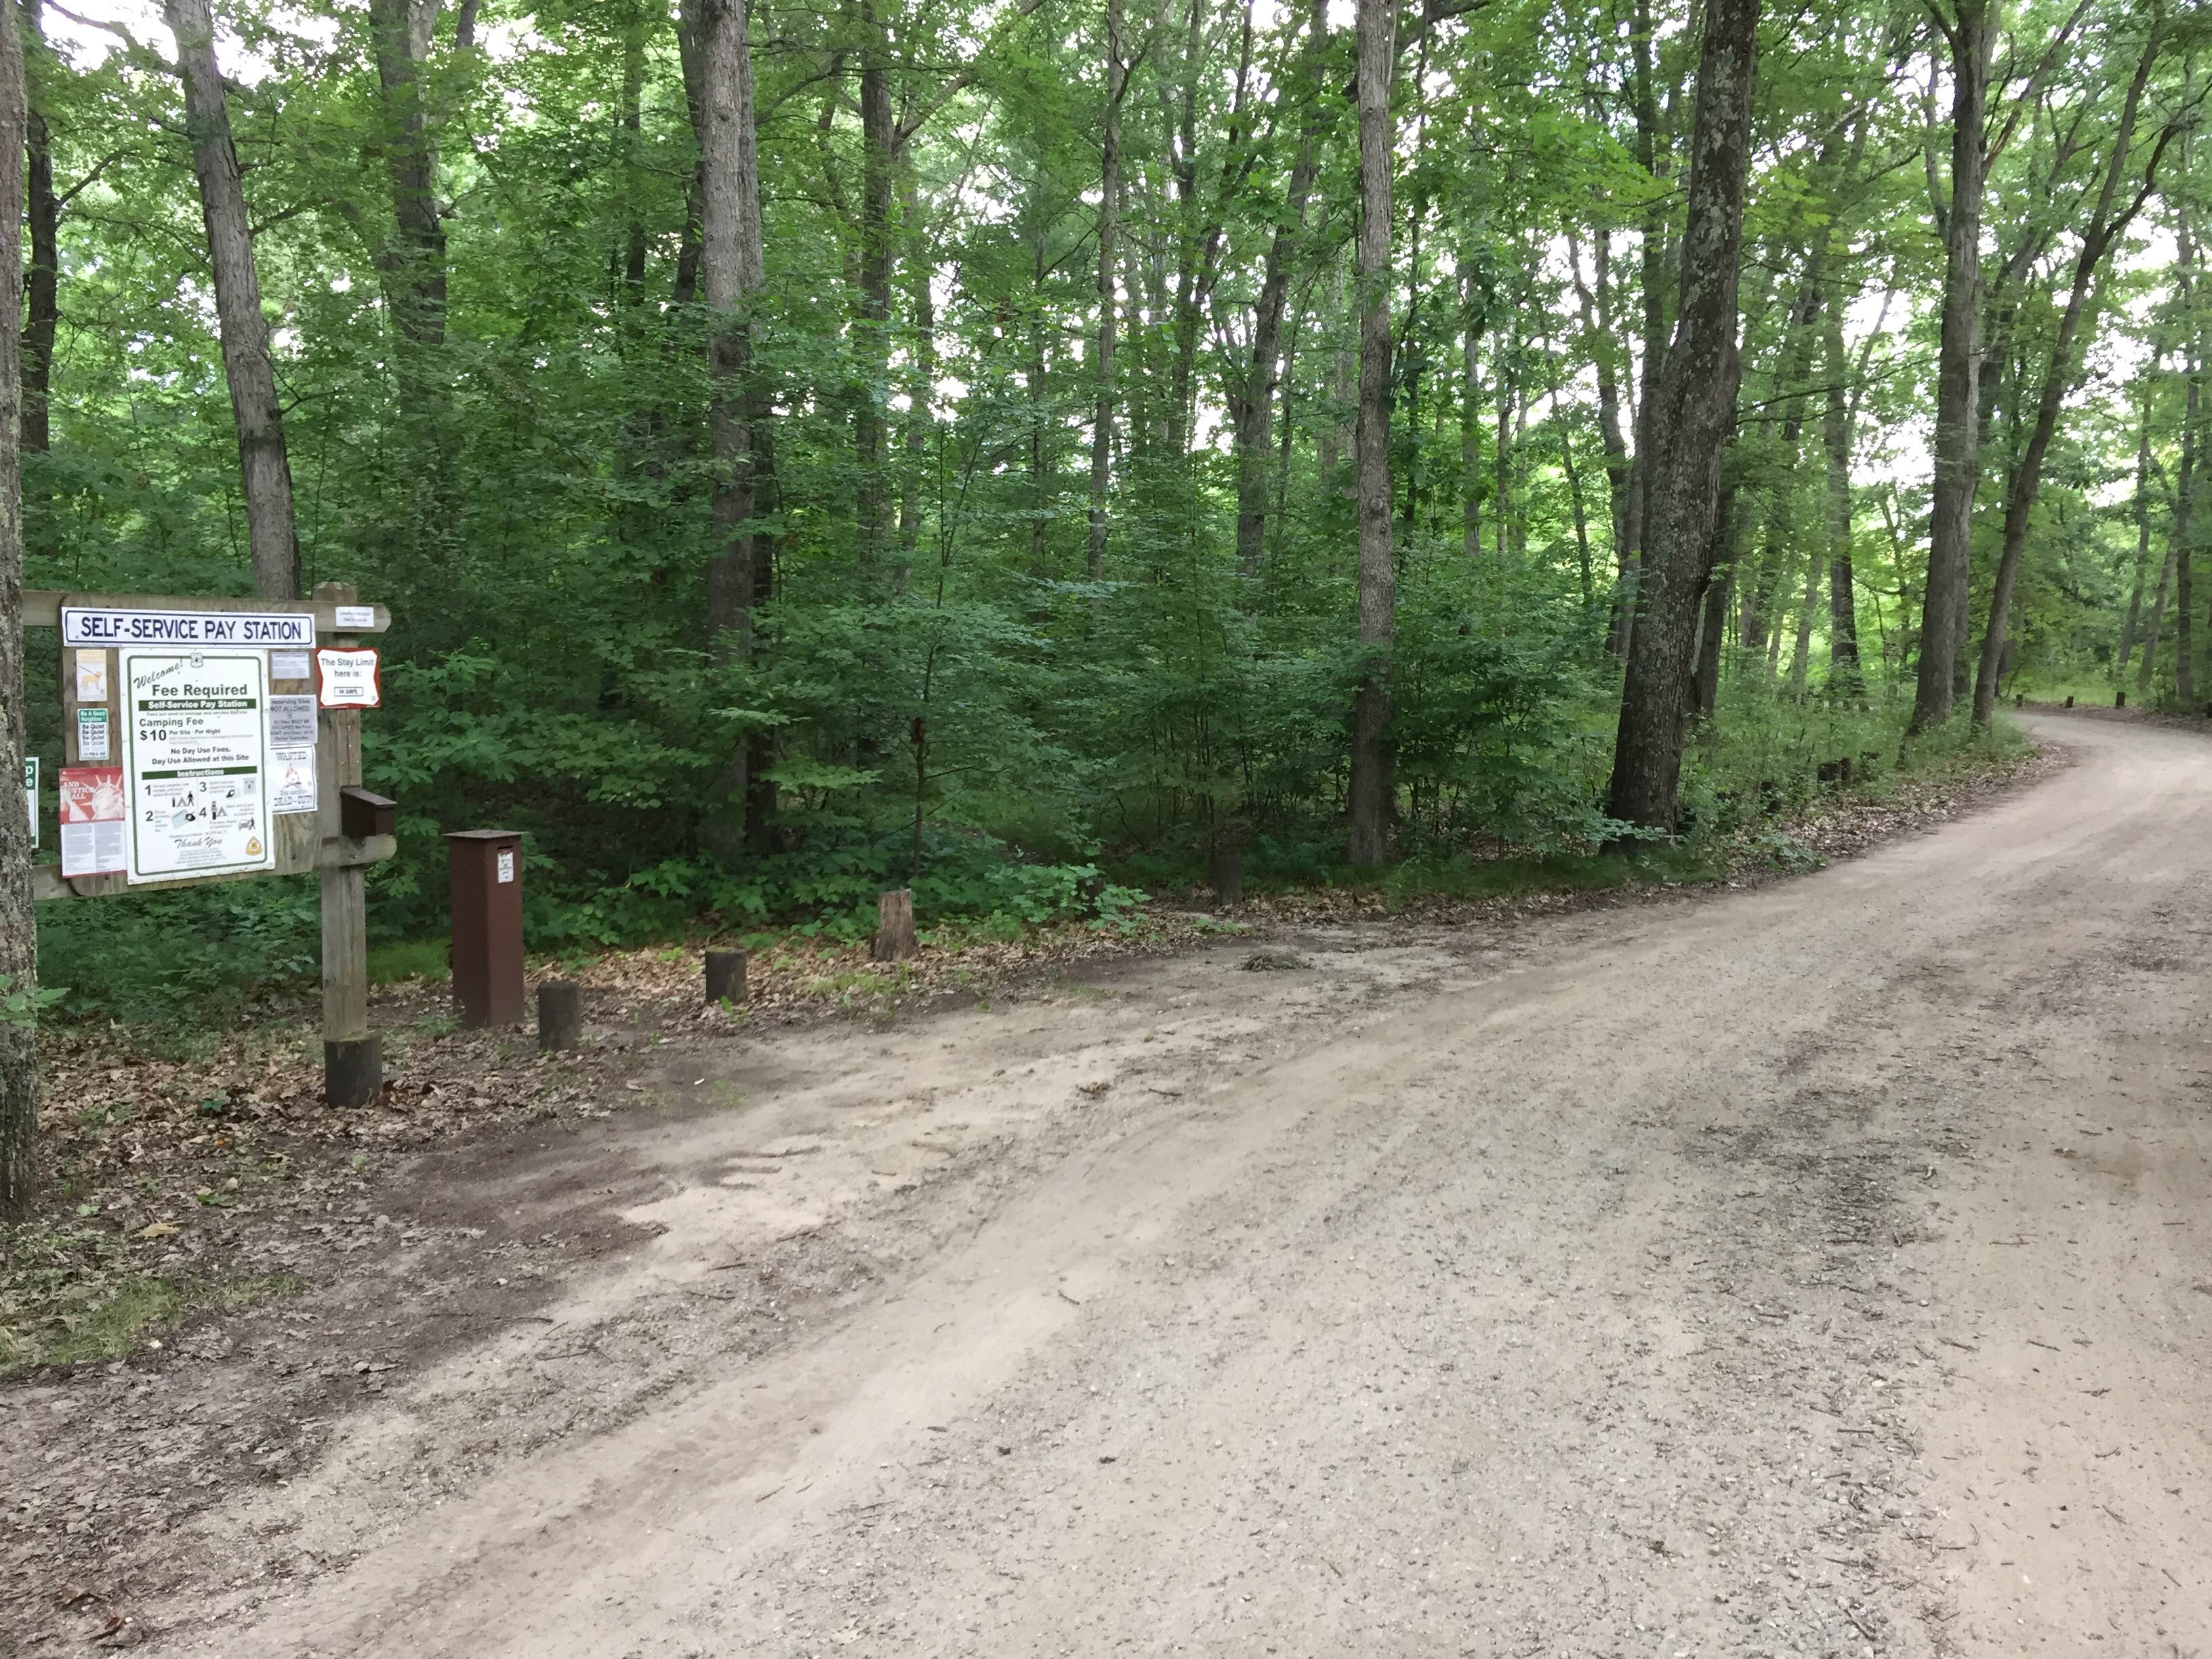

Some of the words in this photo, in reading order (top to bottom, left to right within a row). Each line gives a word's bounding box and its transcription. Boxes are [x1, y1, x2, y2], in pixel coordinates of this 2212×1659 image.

[81, 617, 199, 638] SELF-SERVICE
[205, 620, 236, 639] PAY
[243, 621, 301, 640] STATION
[321, 658, 335, 666] The
[337, 658, 353, 668] Stay
[134, 658, 183, 689] Welcome!
[152, 685, 178, 696] Fee
[184, 684, 247, 698] Required
[148, 701, 199, 710] Self-Service
[201, 701, 216, 709] Pay
[139, 718, 183, 728] Camping
[186, 718, 204, 726] Fee
[140, 729, 167, 741] $10
[177, 769, 225, 778] Instructions
[144, 785, 151, 796] 1
[199, 781, 207, 792] 3
[146, 811, 154, 821] 2
[199, 807, 207, 817] 4
[174, 838, 202, 848] Thank
[204, 836, 223, 848] You
